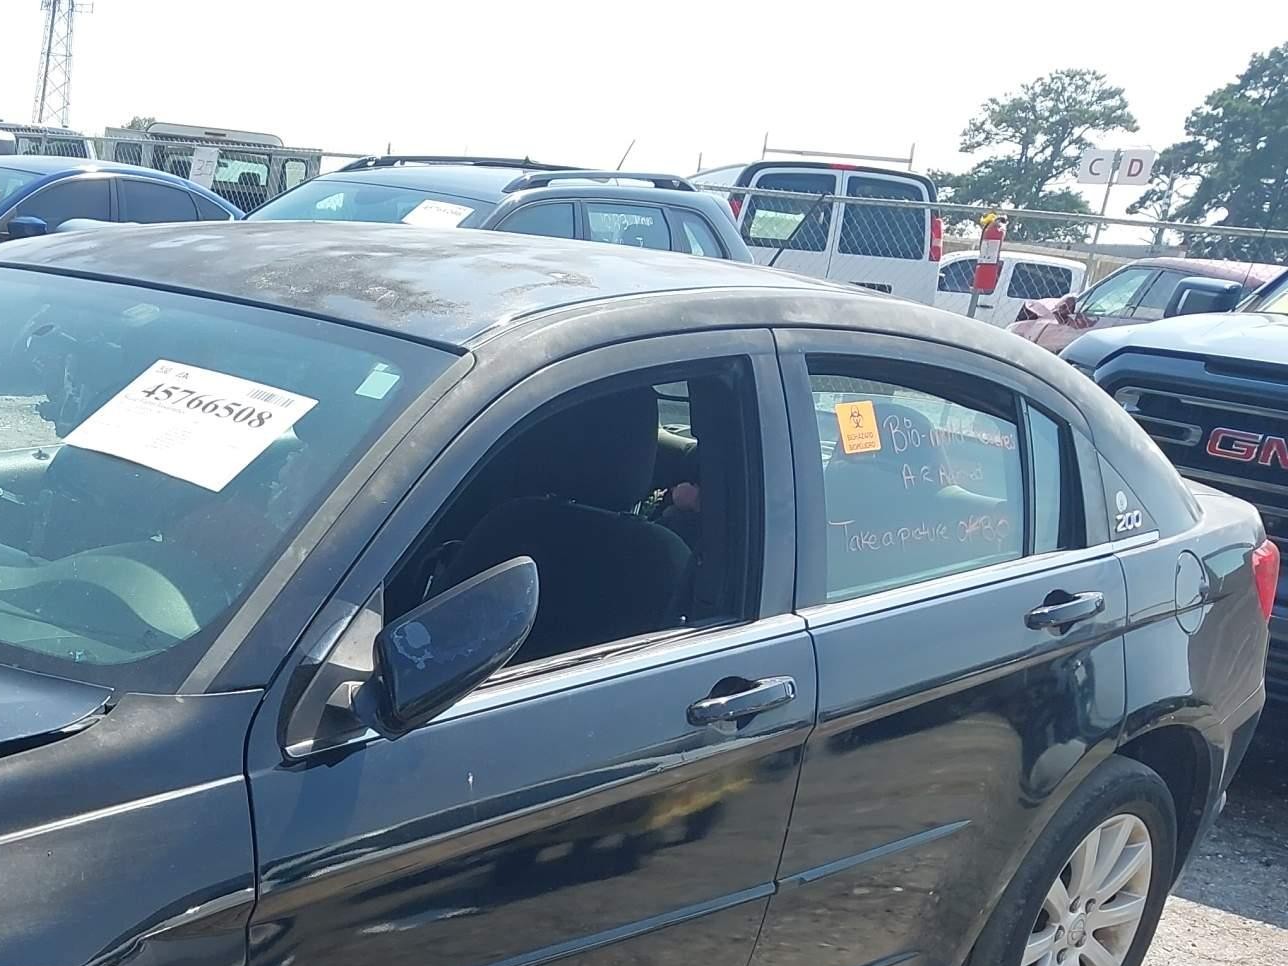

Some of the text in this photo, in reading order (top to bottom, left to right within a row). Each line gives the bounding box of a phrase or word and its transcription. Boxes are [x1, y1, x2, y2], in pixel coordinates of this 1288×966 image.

[1089, 158, 1104, 176] C
[1127, 158, 1143, 177] D
[140, 383, 273, 429] 45766508
[1115, 510, 1142, 532] 200
